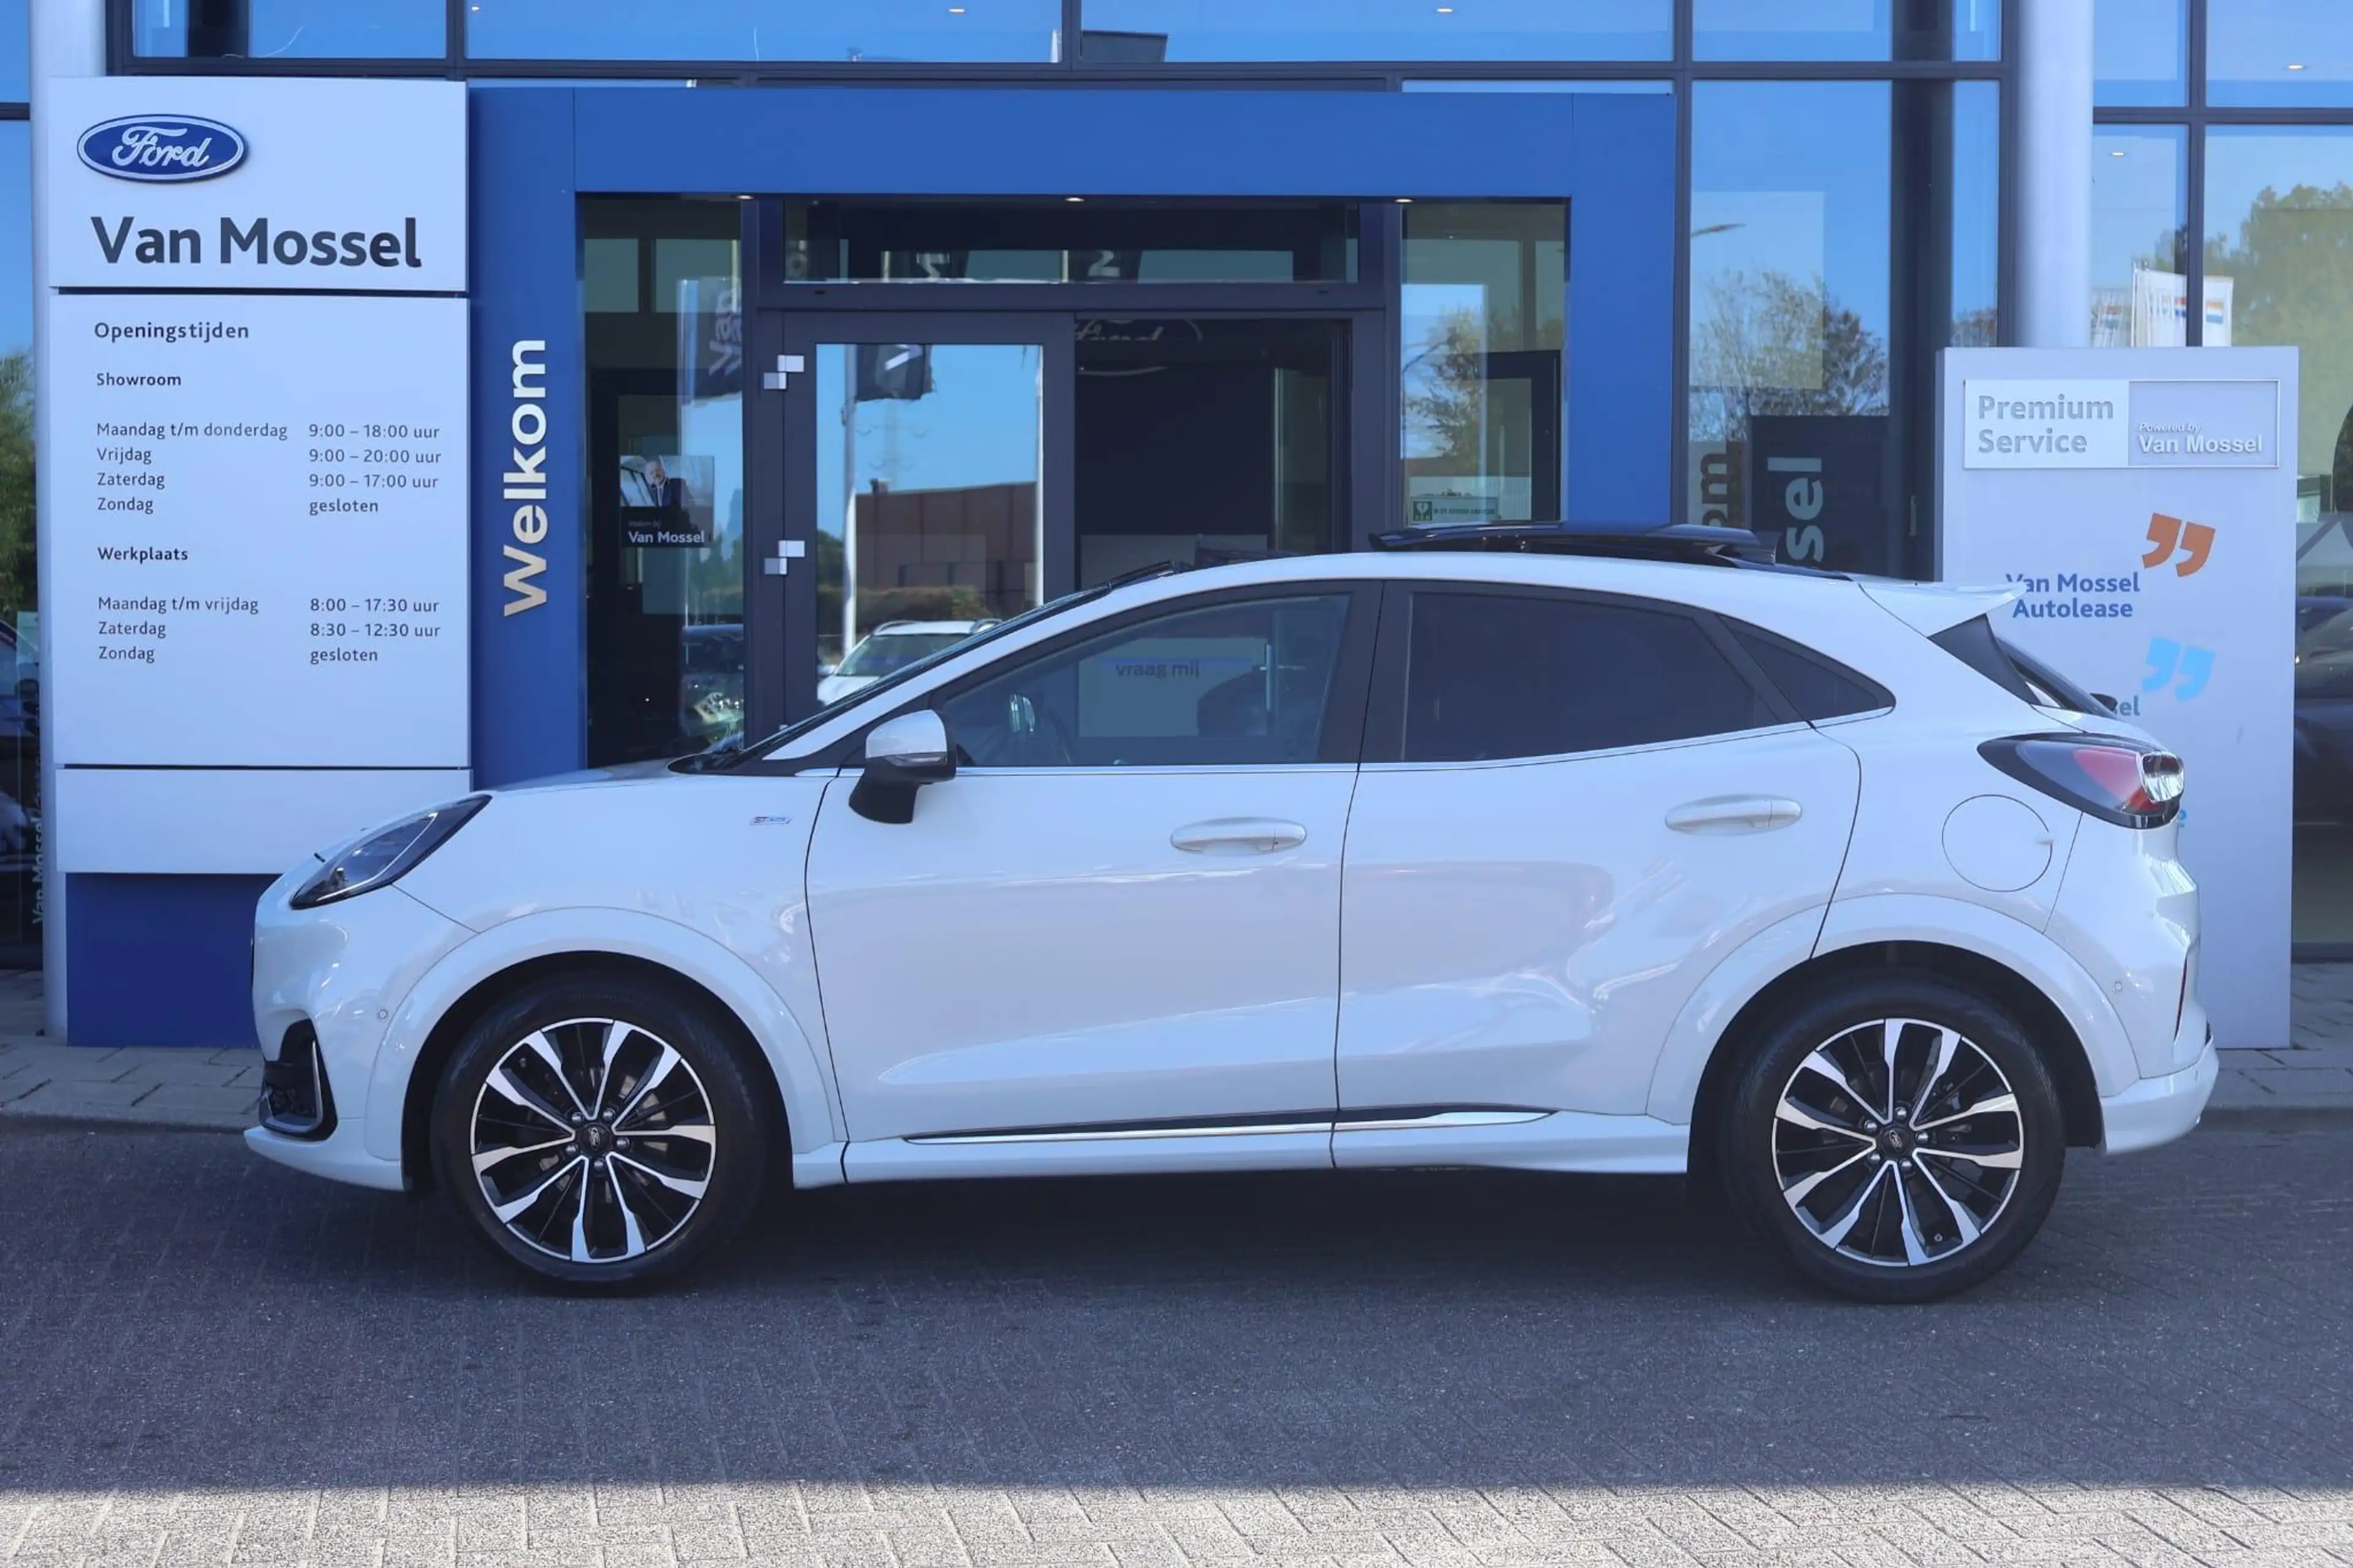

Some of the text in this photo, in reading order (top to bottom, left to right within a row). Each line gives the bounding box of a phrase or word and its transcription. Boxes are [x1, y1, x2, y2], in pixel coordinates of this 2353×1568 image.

[111, 125, 212, 169] Ford
[90, 216, 422, 268] Van Mossel
[94, 321, 249, 344] Openingstijden
[96, 372, 181, 386] Showroom
[1979, 393, 2113, 420] Premium
[97, 421, 165, 441] Maandag
[170, 422, 199, 437] t/m
[203, 422, 288, 441] donderdag
[309, 423, 345, 437] 9:00
[363, 424, 408, 438] 18:00
[414, 428, 440, 439] uur
[2187, 422, 2201, 434] by
[1979, 428, 2087, 453] Service
[2140, 435, 2262, 452] Van Mossel
[96, 446, 152, 466] Vrijdag
[309, 449, 345, 463] 9:00
[363, 449, 410, 463] 20:00
[415, 453, 442, 464] uur
[97, 471, 165, 490] Zaterdag
[309, 473, 345, 487] 9:00
[363, 474, 407, 488] 17:00
[412, 478, 439, 488] uur
[503, 340, 548, 616] Welkom
[97, 496, 379, 517] Zondag gesloten
[628, 530, 705, 543] Van Mossel
[97, 545, 188, 565] Werkplaats
[2058, 572, 2140, 593] Mossel
[98, 596, 167, 615] Maandag
[171, 596, 200, 612] t/m
[205, 597, 259, 615] vrijdag
[310, 597, 346, 612] 8:00
[365, 598, 407, 612] 17:30
[413, 602, 440, 613] uur
[2012, 597, 2133, 618] Autolease
[98, 620, 167, 640] Zaterdag
[310, 623, 346, 637] 8:30
[364, 623, 409, 637] 12:30
[414, 627, 441, 637] uur
[98, 645, 378, 665] Zondag gesloten
[1116, 664, 1166, 679] vraag
